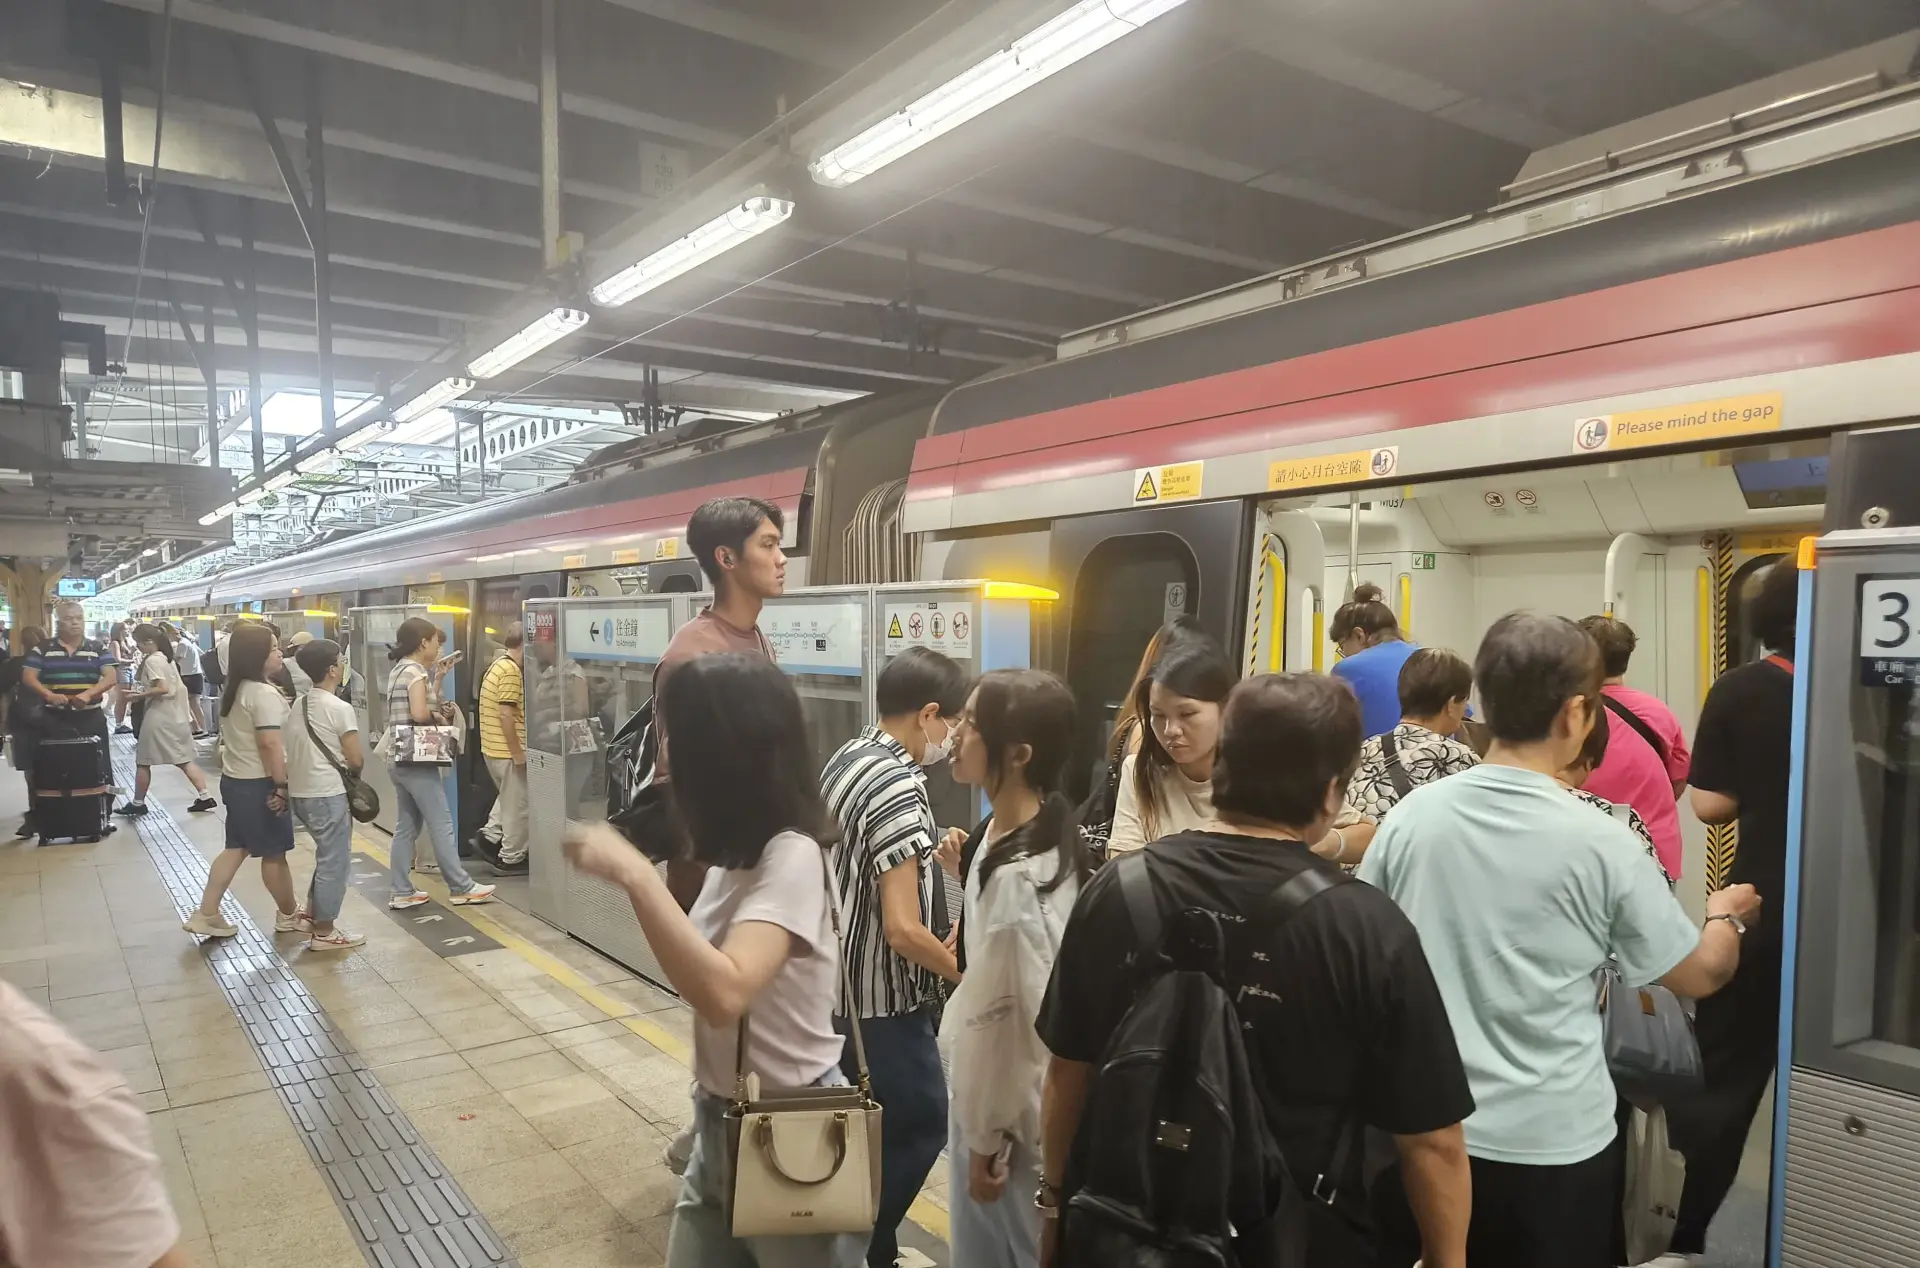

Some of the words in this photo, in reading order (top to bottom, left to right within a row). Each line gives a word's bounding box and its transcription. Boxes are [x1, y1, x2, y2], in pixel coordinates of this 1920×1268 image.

[1616, 420, 1663, 435] Please
[1667, 411, 1707, 428] mind
[1711, 408, 1738, 423] the
[1742, 405, 1774, 422] gap
[1275, 460, 1362, 483] 請小心月台空隙
